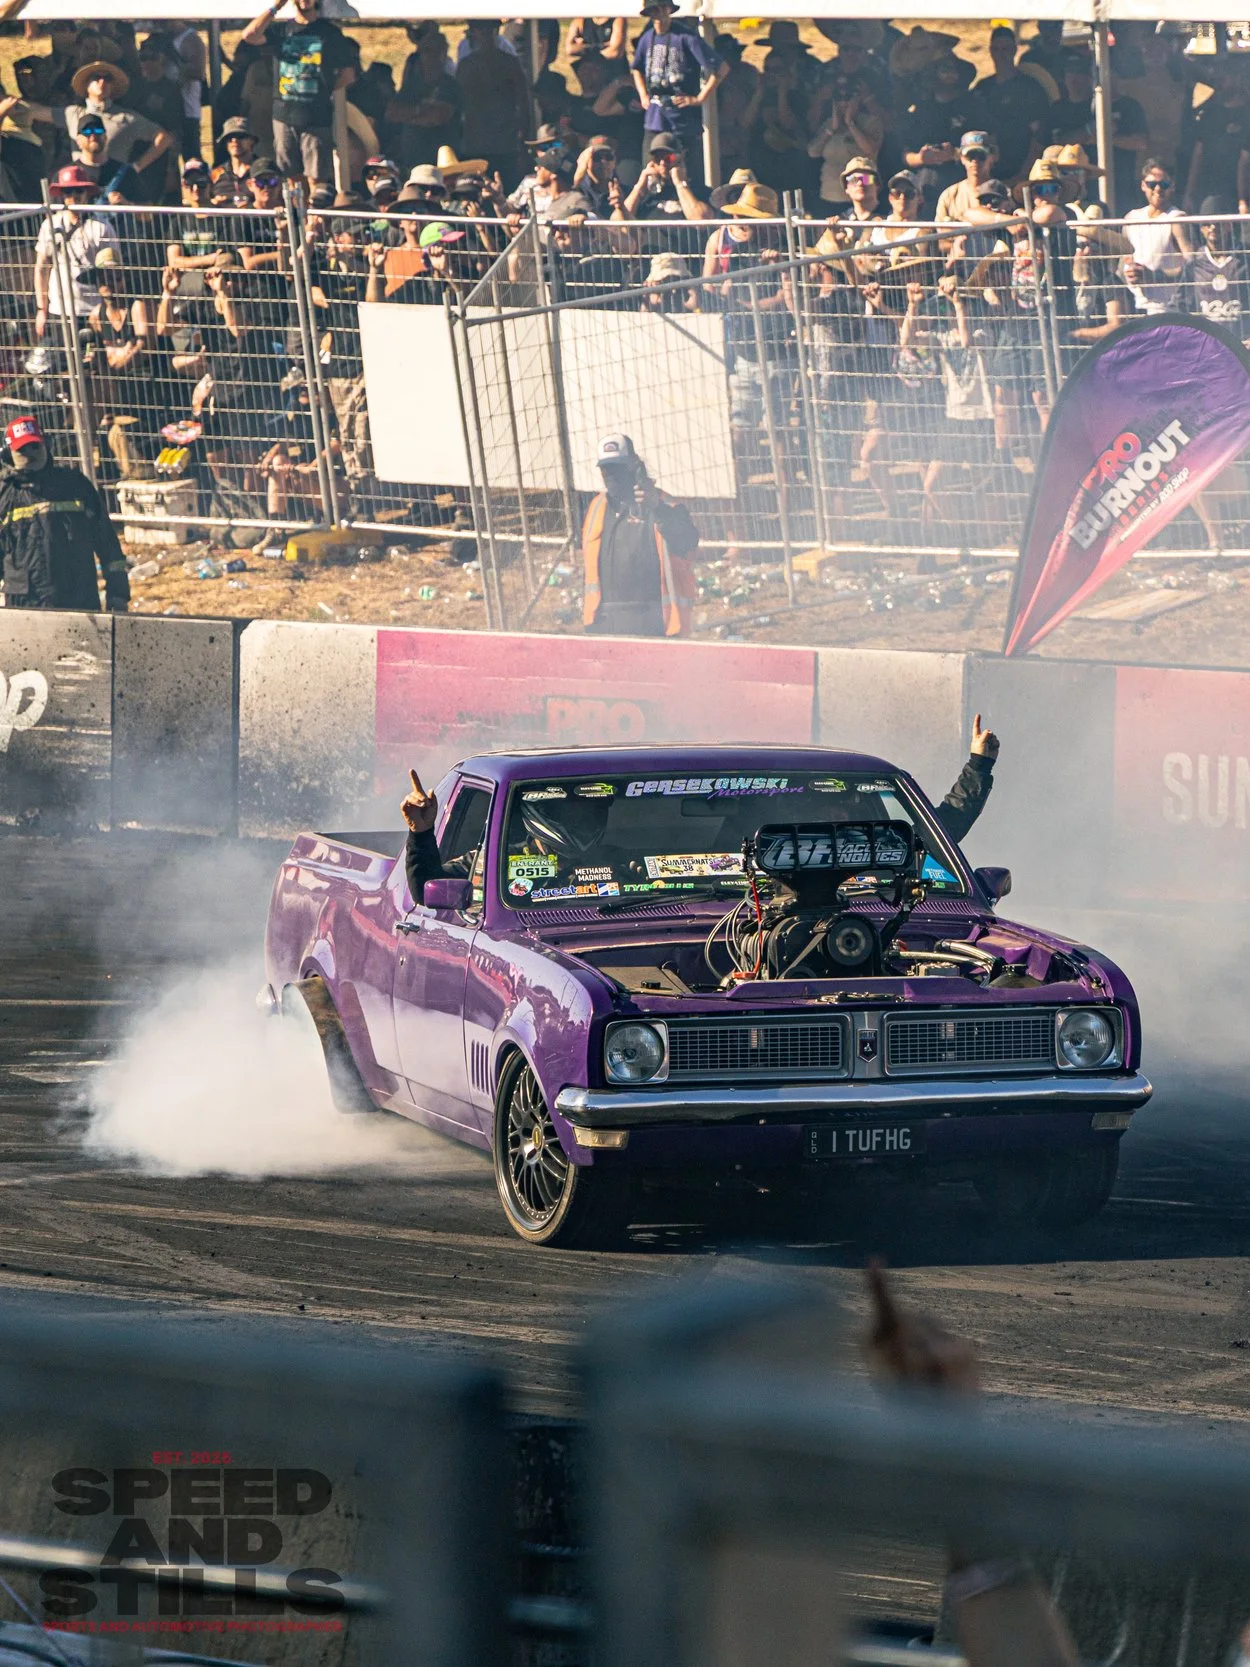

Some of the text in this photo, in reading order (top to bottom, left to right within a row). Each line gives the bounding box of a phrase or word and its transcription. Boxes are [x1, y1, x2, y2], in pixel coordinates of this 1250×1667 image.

[1069, 419, 1190, 550] BURNOUT
[707, 785, 805, 800] Motorsport
[774, 840, 844, 865] BF
[828, 851, 903, 863] ENGINES
[510, 859, 554, 867] ENTRANT
[661, 858, 716, 867] SUMMERNATS
[516, 867, 549, 877] 0515
[575, 867, 613, 875] METHANOL
[578, 873, 612, 881] MADNESS
[531, 883, 598, 898] streetart
[845, 1128, 911, 1152] TUFHG
